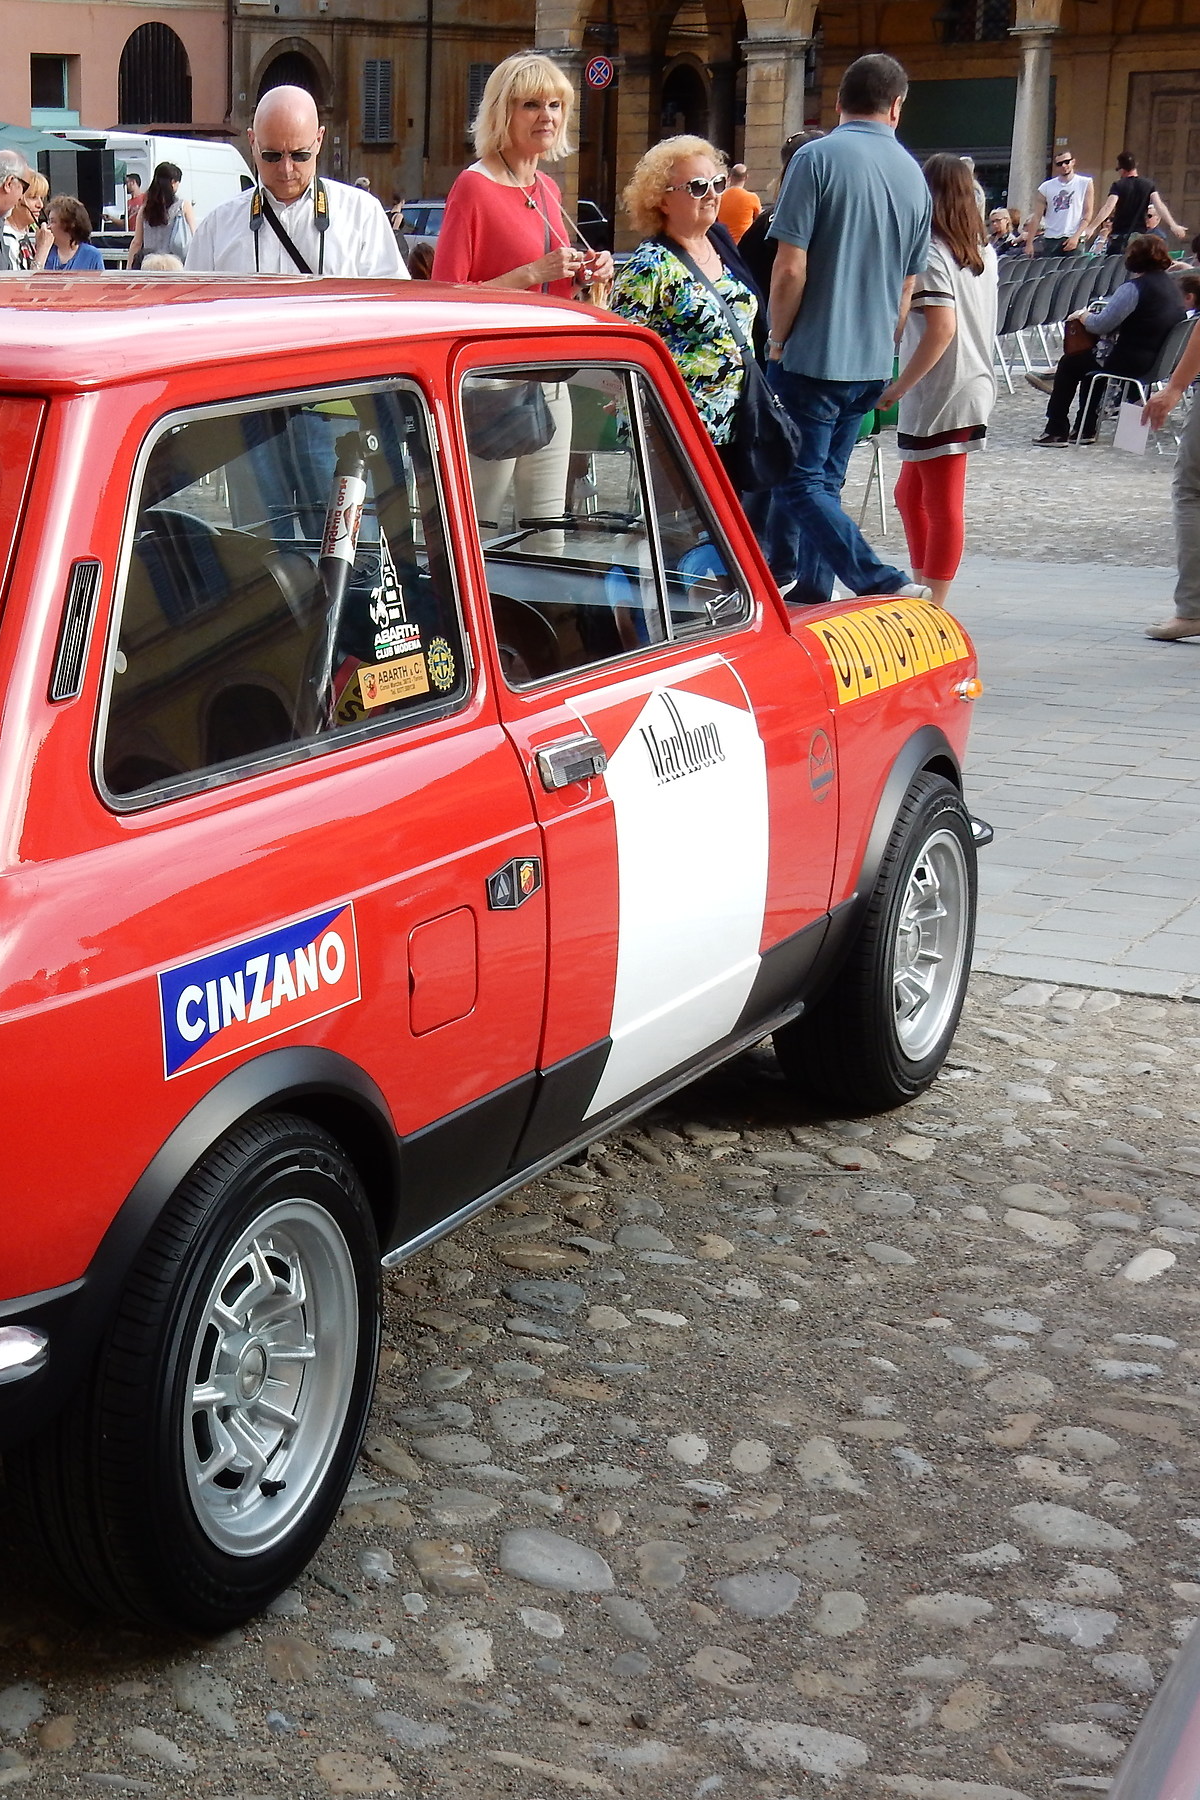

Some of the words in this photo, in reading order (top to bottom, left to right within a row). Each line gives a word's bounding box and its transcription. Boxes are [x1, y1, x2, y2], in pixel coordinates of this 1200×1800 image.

[327, 510, 342, 554] modena
[337, 477, 348, 507] corse
[374, 623, 420, 646] ABARTH
[376, 647, 394, 660] CLUB
[395, 639, 422, 655] MODENA
[378, 665, 408, 685] ABARTH
[639, 691, 726, 787] Marlboro
[176, 931, 346, 1042] CINZANO
